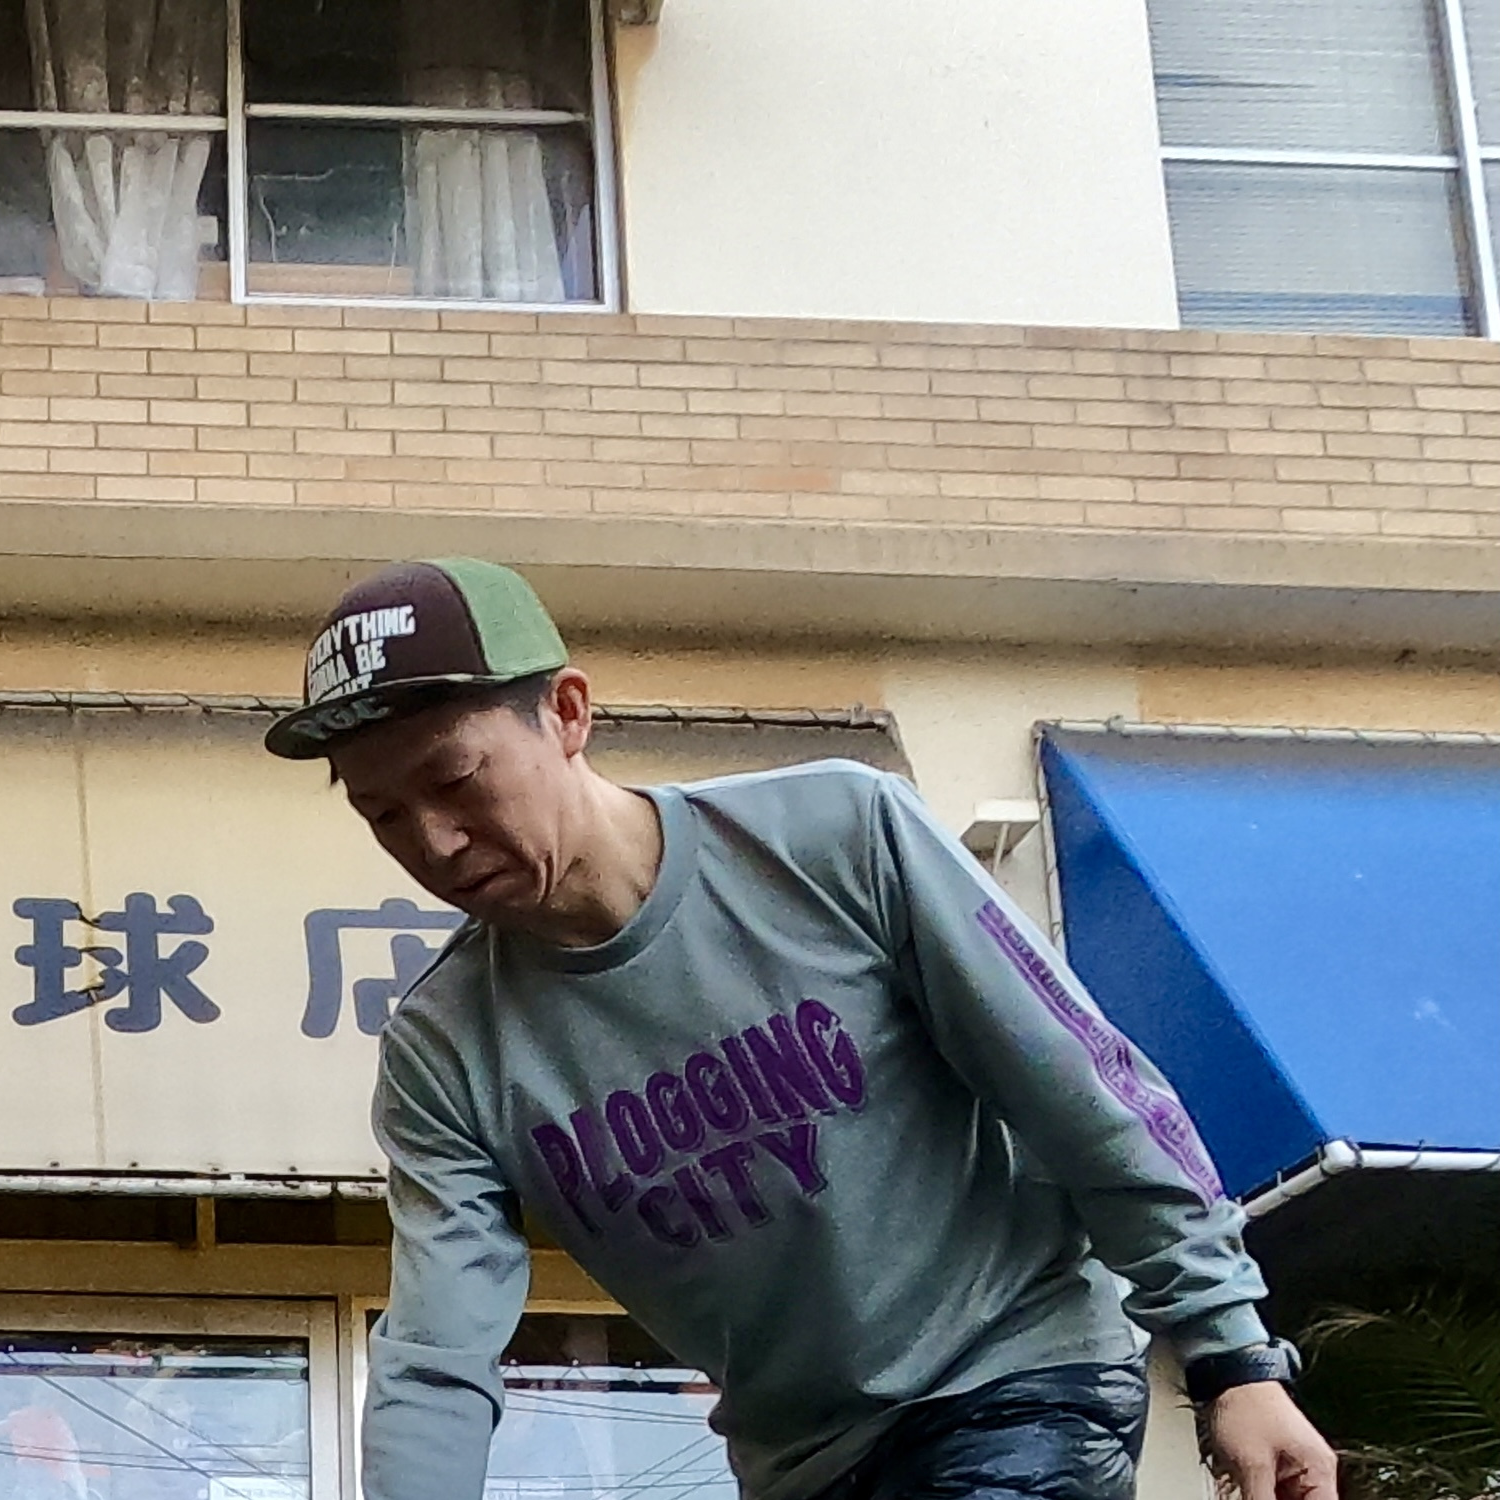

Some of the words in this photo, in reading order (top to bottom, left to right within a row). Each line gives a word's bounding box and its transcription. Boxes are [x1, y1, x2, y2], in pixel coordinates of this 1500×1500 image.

[355, 638, 387, 675] BE
[530, 999, 867, 1233] PLOGGING
[636, 1123, 830, 1248] CITY
